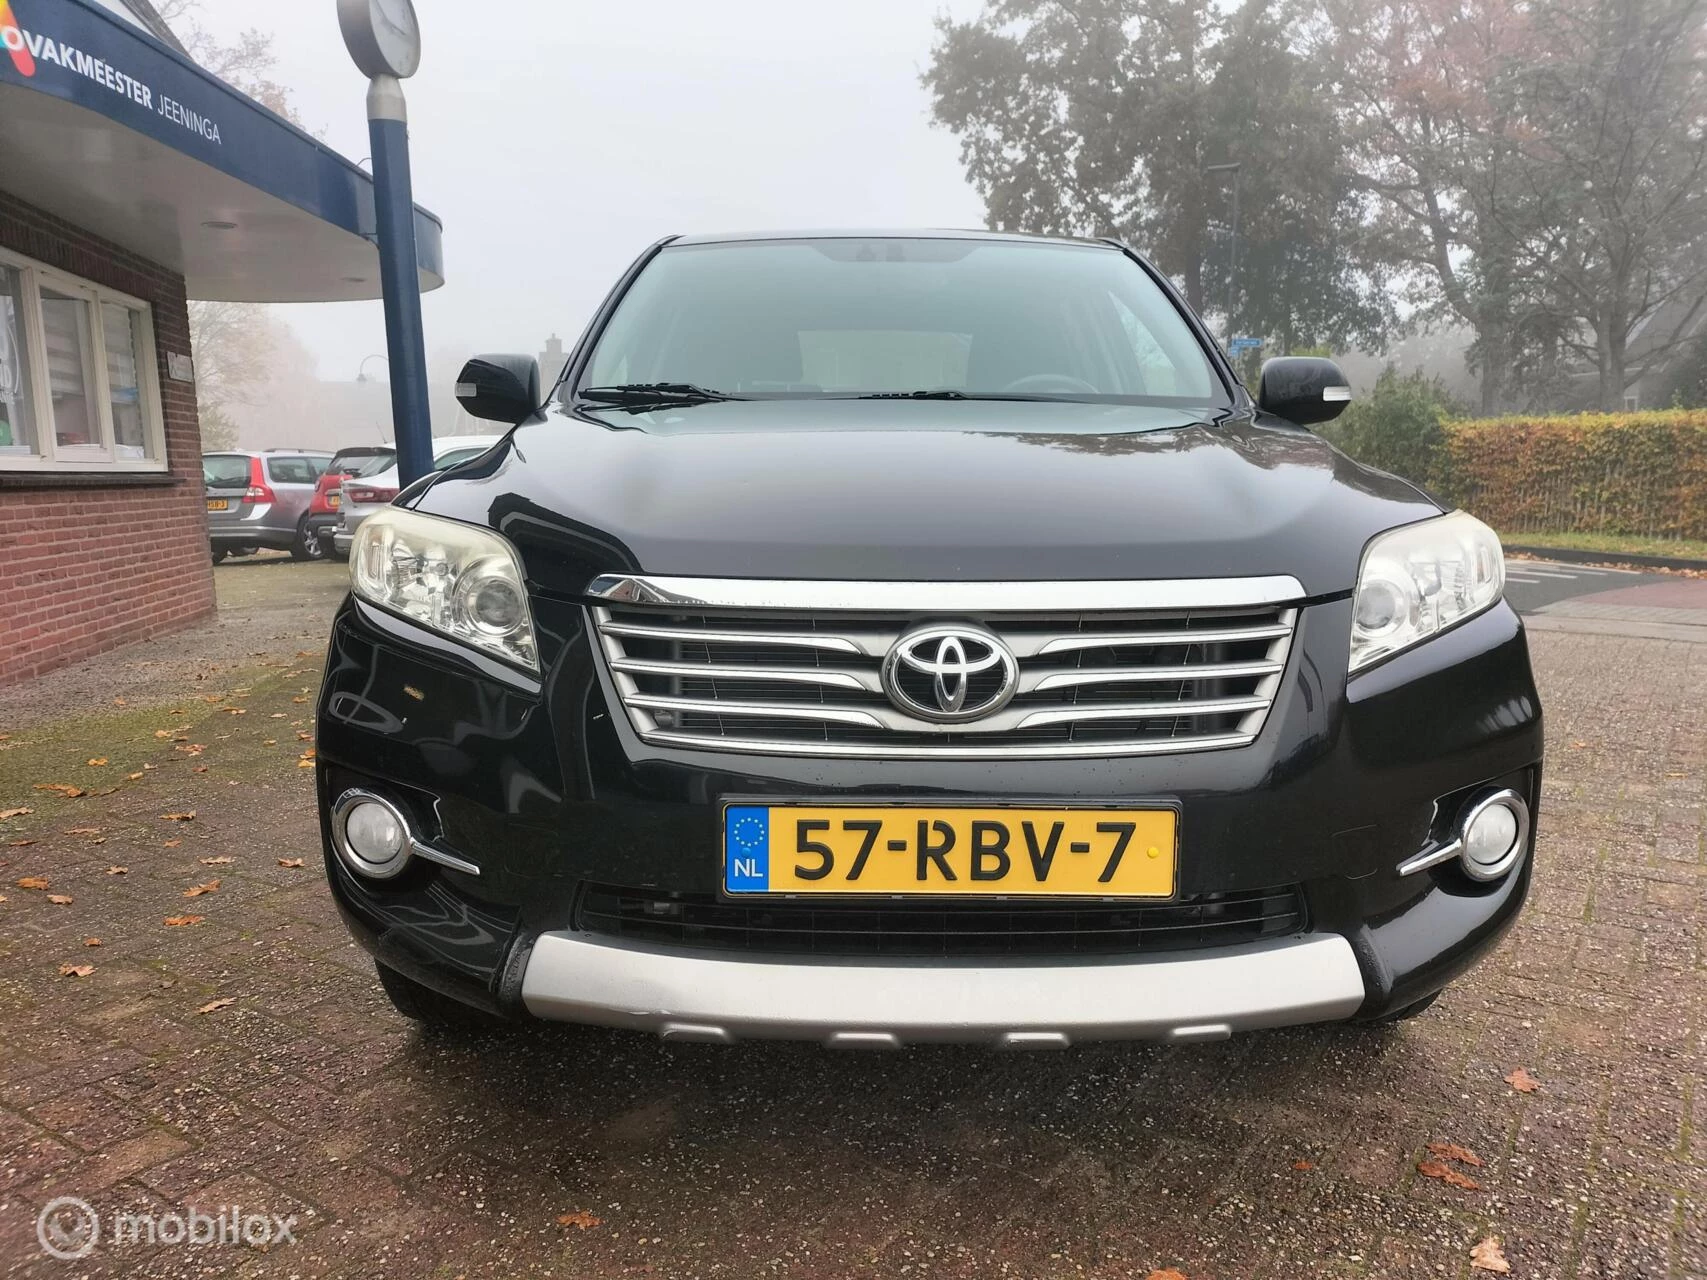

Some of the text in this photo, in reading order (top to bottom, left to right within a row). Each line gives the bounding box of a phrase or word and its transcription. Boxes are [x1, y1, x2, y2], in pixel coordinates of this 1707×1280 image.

[157, 94, 222, 145] JEENINGA
[734, 857, 764, 878] NL
[794, 819, 1137, 882] 57-RBV-7
